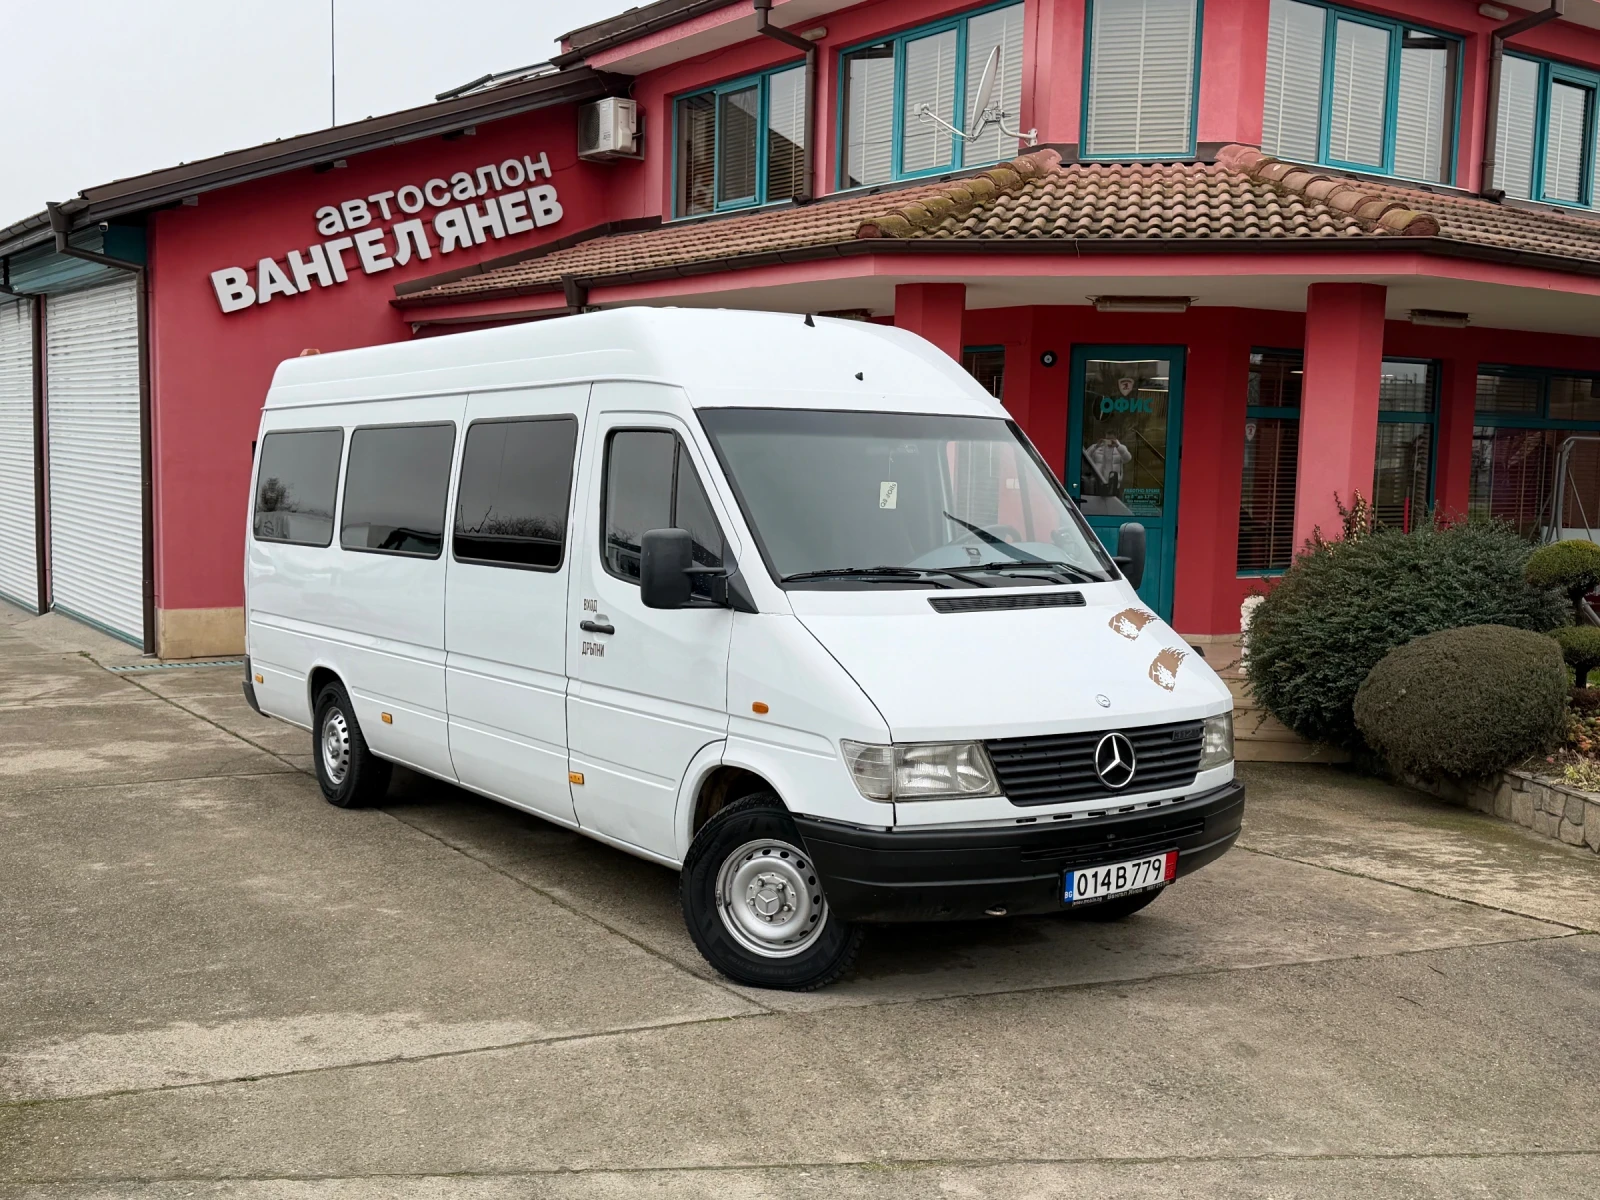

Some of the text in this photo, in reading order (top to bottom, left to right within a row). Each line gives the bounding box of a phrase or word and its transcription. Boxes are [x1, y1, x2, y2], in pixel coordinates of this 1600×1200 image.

[315, 151, 552, 236] автосалон
[210, 184, 564, 313] ВАНГЕЛ ЯНЕВ
[1100, 397, 1154, 413] ОФИС
[583, 598, 598, 613] ВХОД
[1064, 890, 1073, 899] BG
